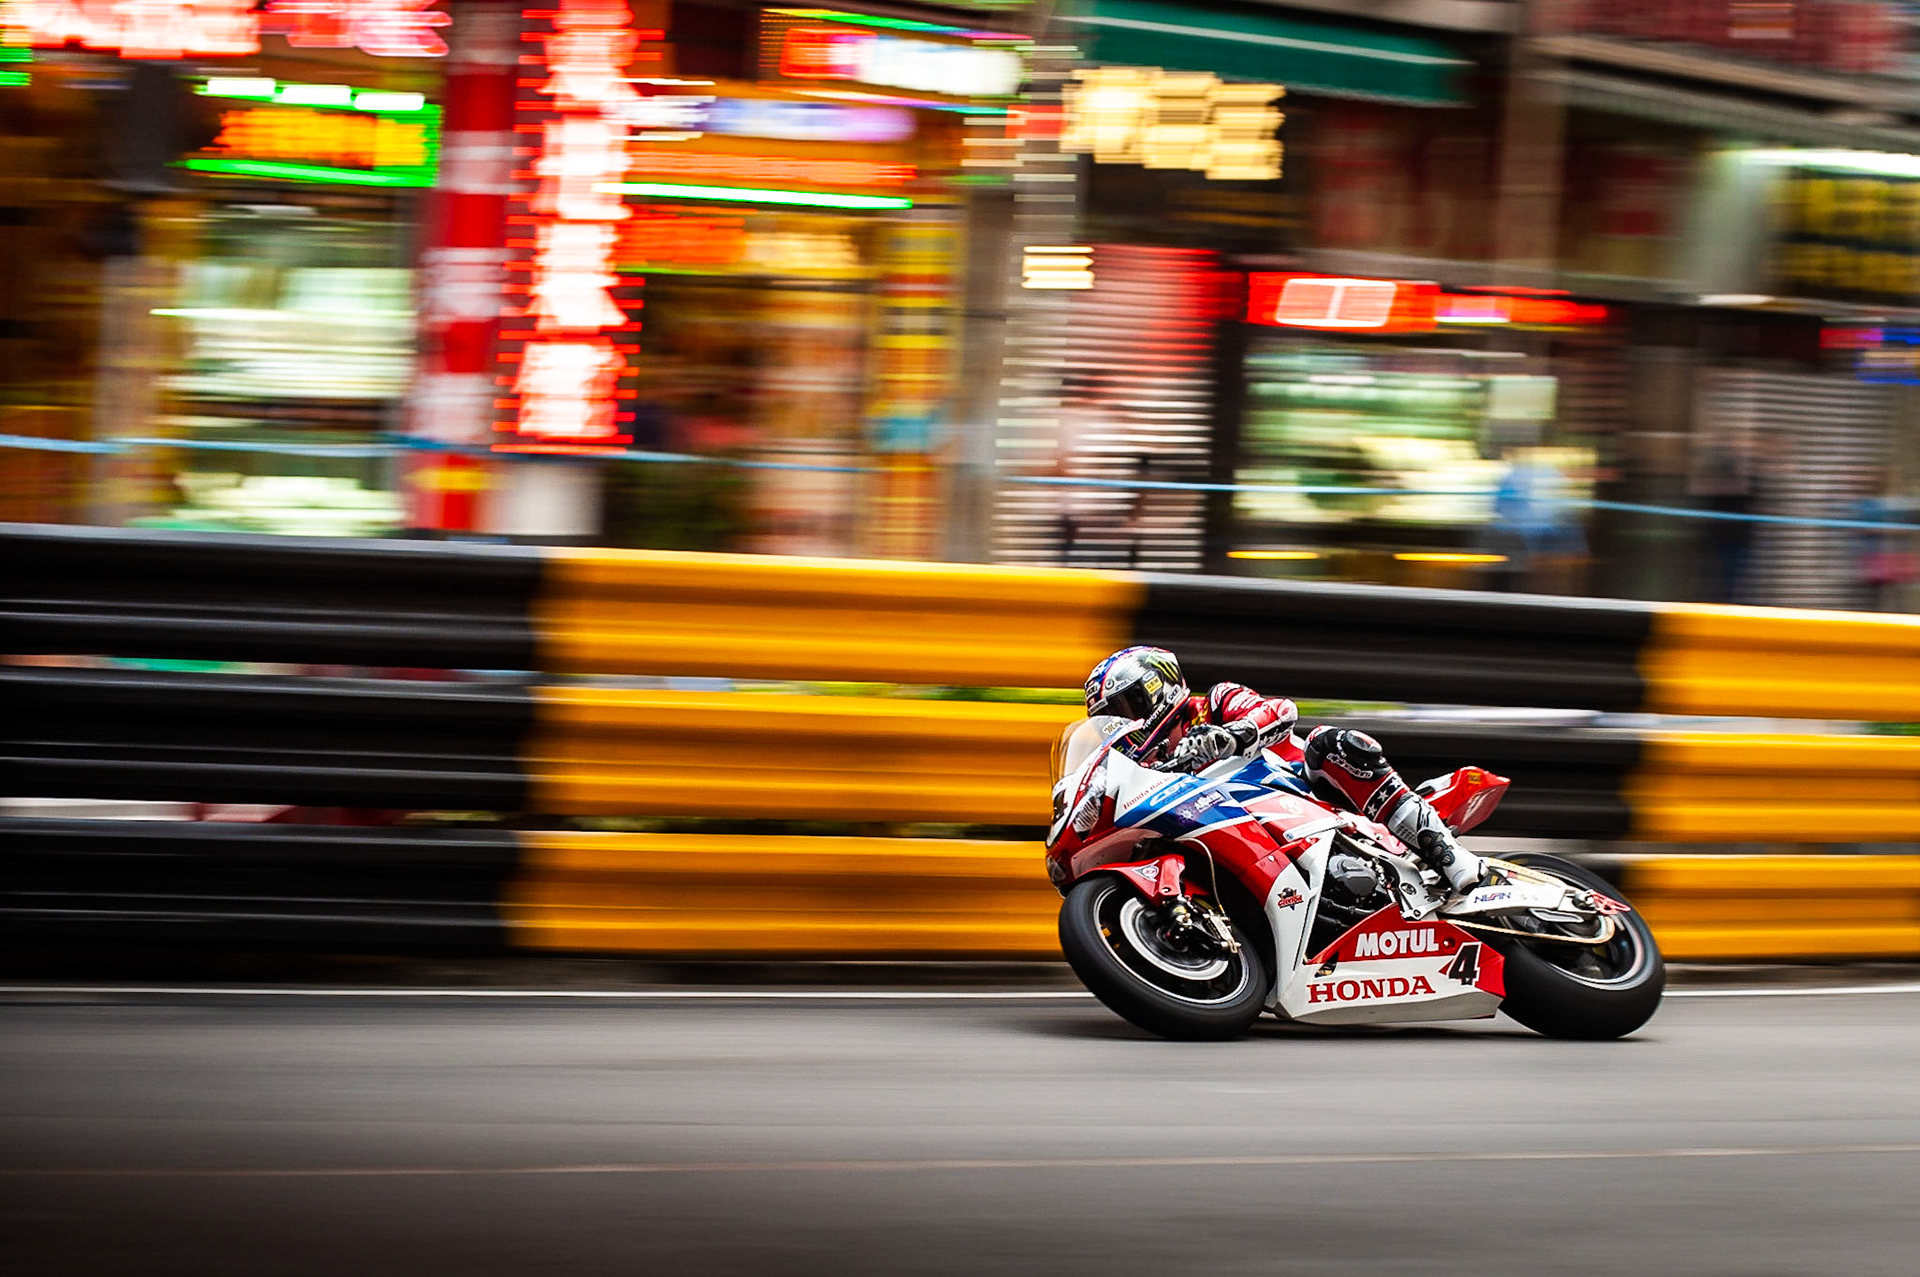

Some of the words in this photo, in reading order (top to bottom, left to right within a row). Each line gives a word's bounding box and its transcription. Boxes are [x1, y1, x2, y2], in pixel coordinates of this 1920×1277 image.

[1355, 928, 1439, 957] MOTUL
[1448, 942, 1482, 986] 4
[1307, 976, 1436, 1003] HONDA
